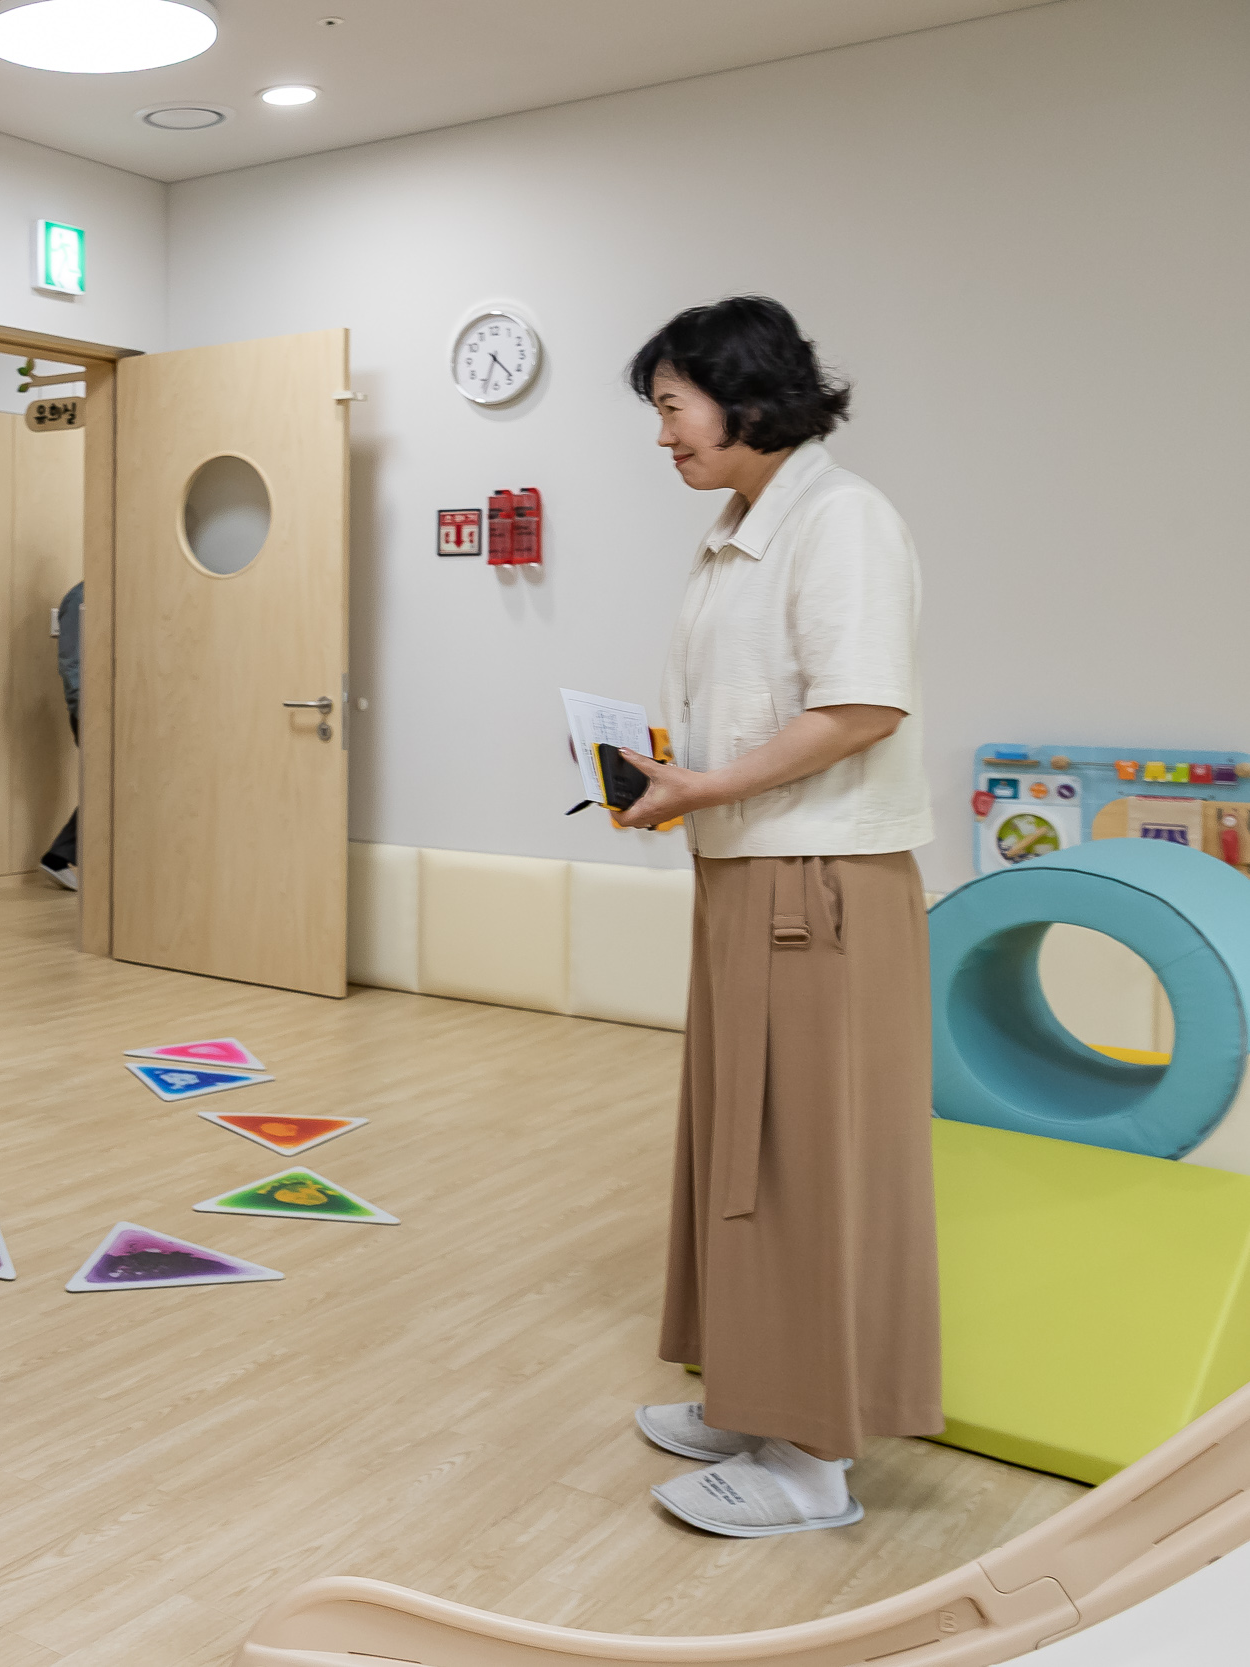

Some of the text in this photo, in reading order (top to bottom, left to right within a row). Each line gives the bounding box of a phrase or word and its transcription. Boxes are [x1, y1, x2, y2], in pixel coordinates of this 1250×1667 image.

[489, 325, 500, 337] 12
[506, 328, 512, 337] 1
[515, 336, 523, 347] 2
[467, 342, 479, 353] 10
[519, 349, 526, 360] 3
[466, 357, 473, 367] 9
[515, 363, 523, 372] 4
[469, 370, 477, 380] 8
[34, 402, 77, 425] 유희실
